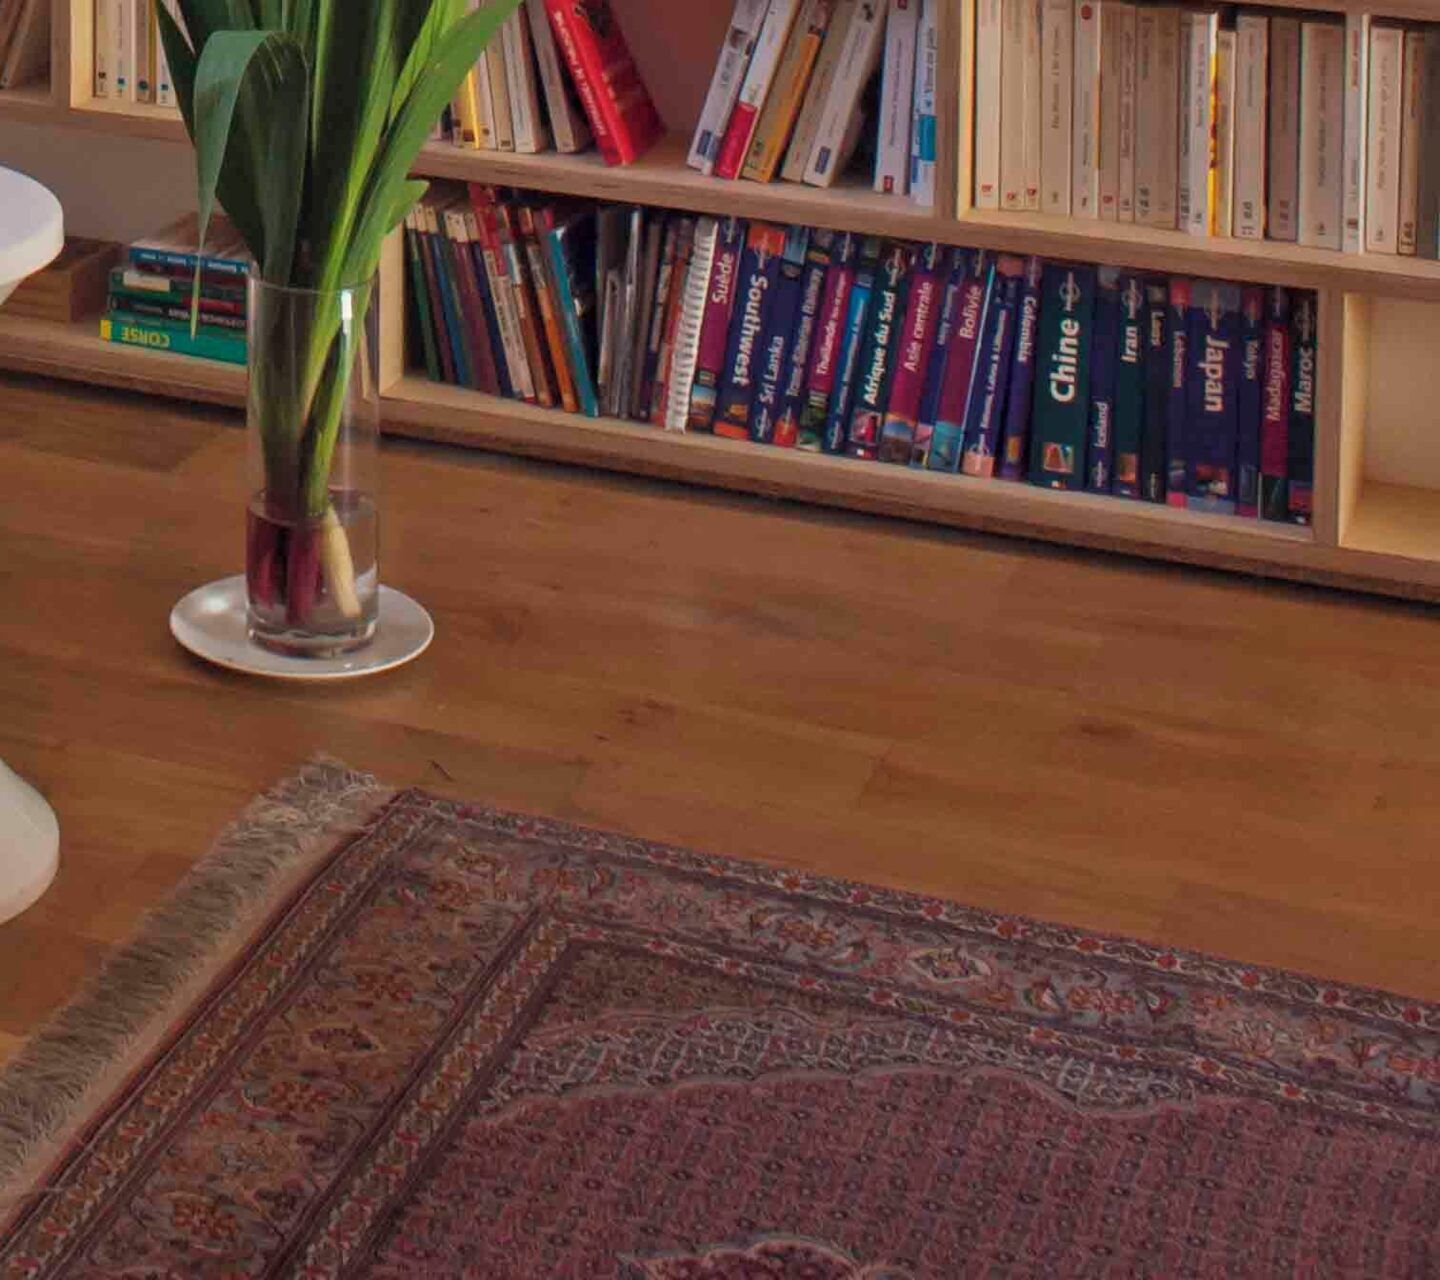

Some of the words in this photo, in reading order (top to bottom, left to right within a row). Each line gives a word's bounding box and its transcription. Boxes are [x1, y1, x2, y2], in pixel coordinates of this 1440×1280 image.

[712, 251, 734, 304] Suède
[732, 274, 769, 385] Southwest
[878, 290, 896, 322] Sud
[910, 281, 933, 339] centrale
[959, 284, 982, 339] Bolivie
[121, 326, 171, 348] CORSE
[765, 335, 785, 381] Lanka
[874, 324, 889, 345] du
[903, 341, 923, 372] Asie
[1050, 319, 1079, 402] Chine
[1122, 326, 1138, 363] Iran
[759, 382, 777, 404] Sri
[864, 347, 888, 405] Afrique
[1197, 335, 1229, 412] Japan
[1267, 329, 1284, 421] Madagascar
[1294, 348, 1313, 412] Maroc
[1095, 402, 1107, 448] Iceland
